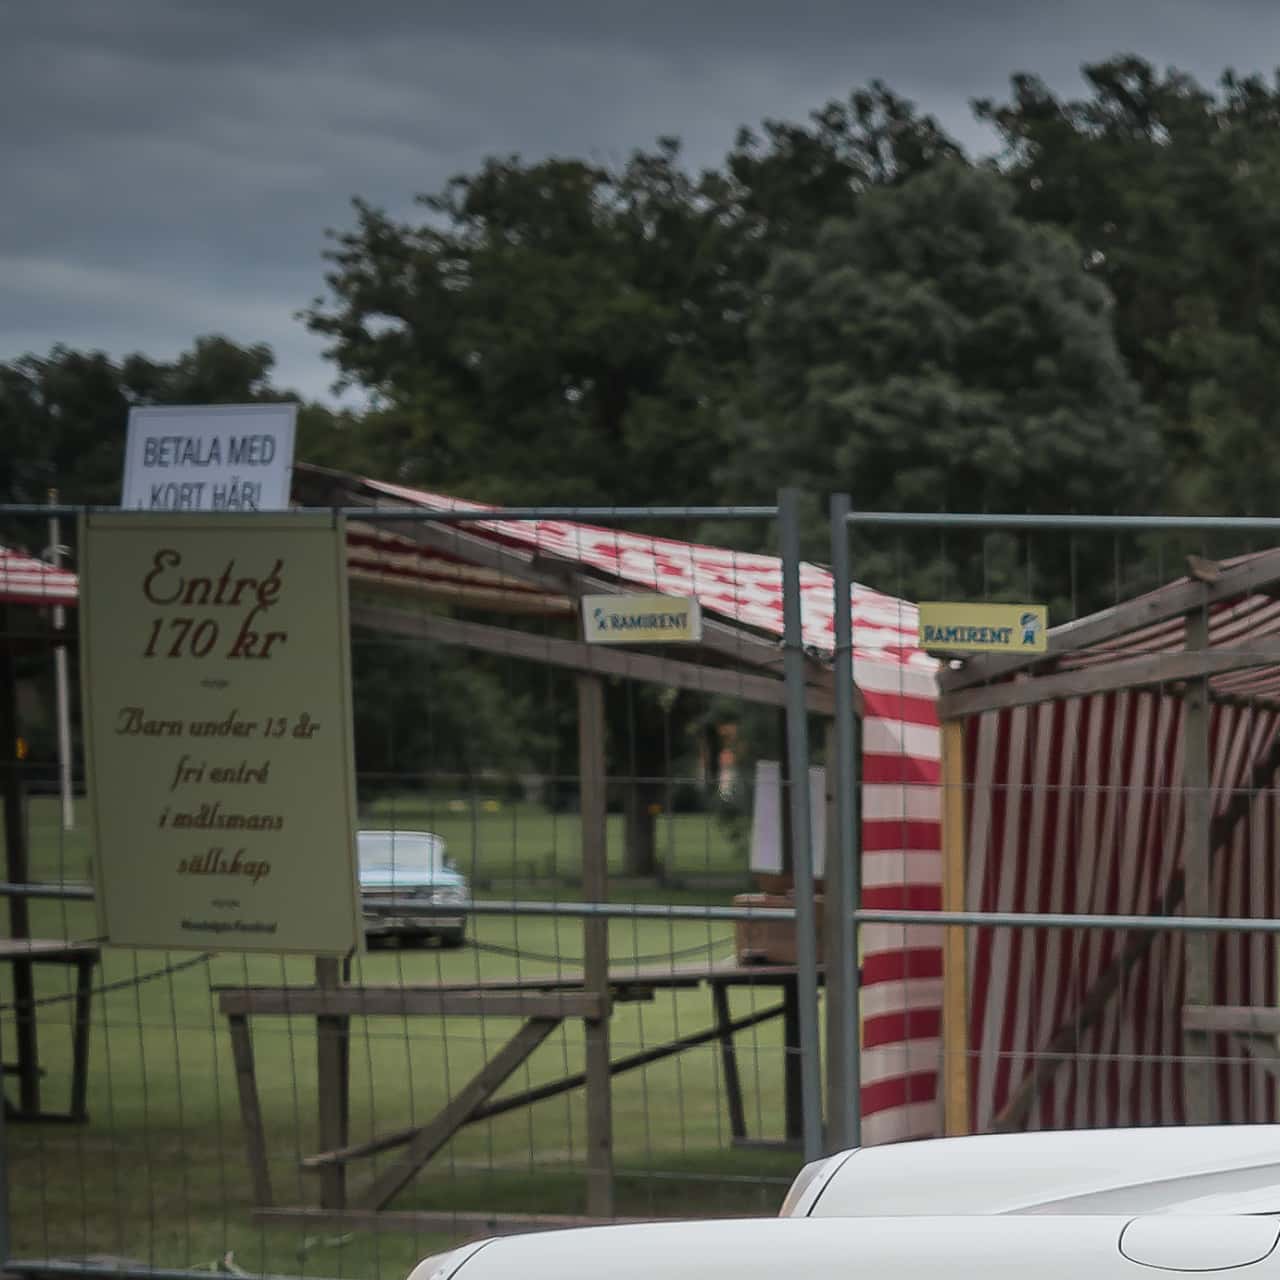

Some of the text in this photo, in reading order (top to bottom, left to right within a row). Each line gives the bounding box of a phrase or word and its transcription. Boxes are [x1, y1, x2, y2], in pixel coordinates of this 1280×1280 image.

[144, 434, 276, 467] BETALA MED
[150, 481, 206, 511] KORT
[143, 549, 285, 607] Entré
[143, 604, 289, 660] 170 kr
[609, 612, 688, 631] RAMIRENT
[923, 624, 1013, 645] RAMIRENT
[115, 706, 320, 740] Barn under 15 år
[170, 754, 271, 792] fri entré
[159, 800, 284, 831] i målsmans
[176, 847, 272, 887] sällskap
